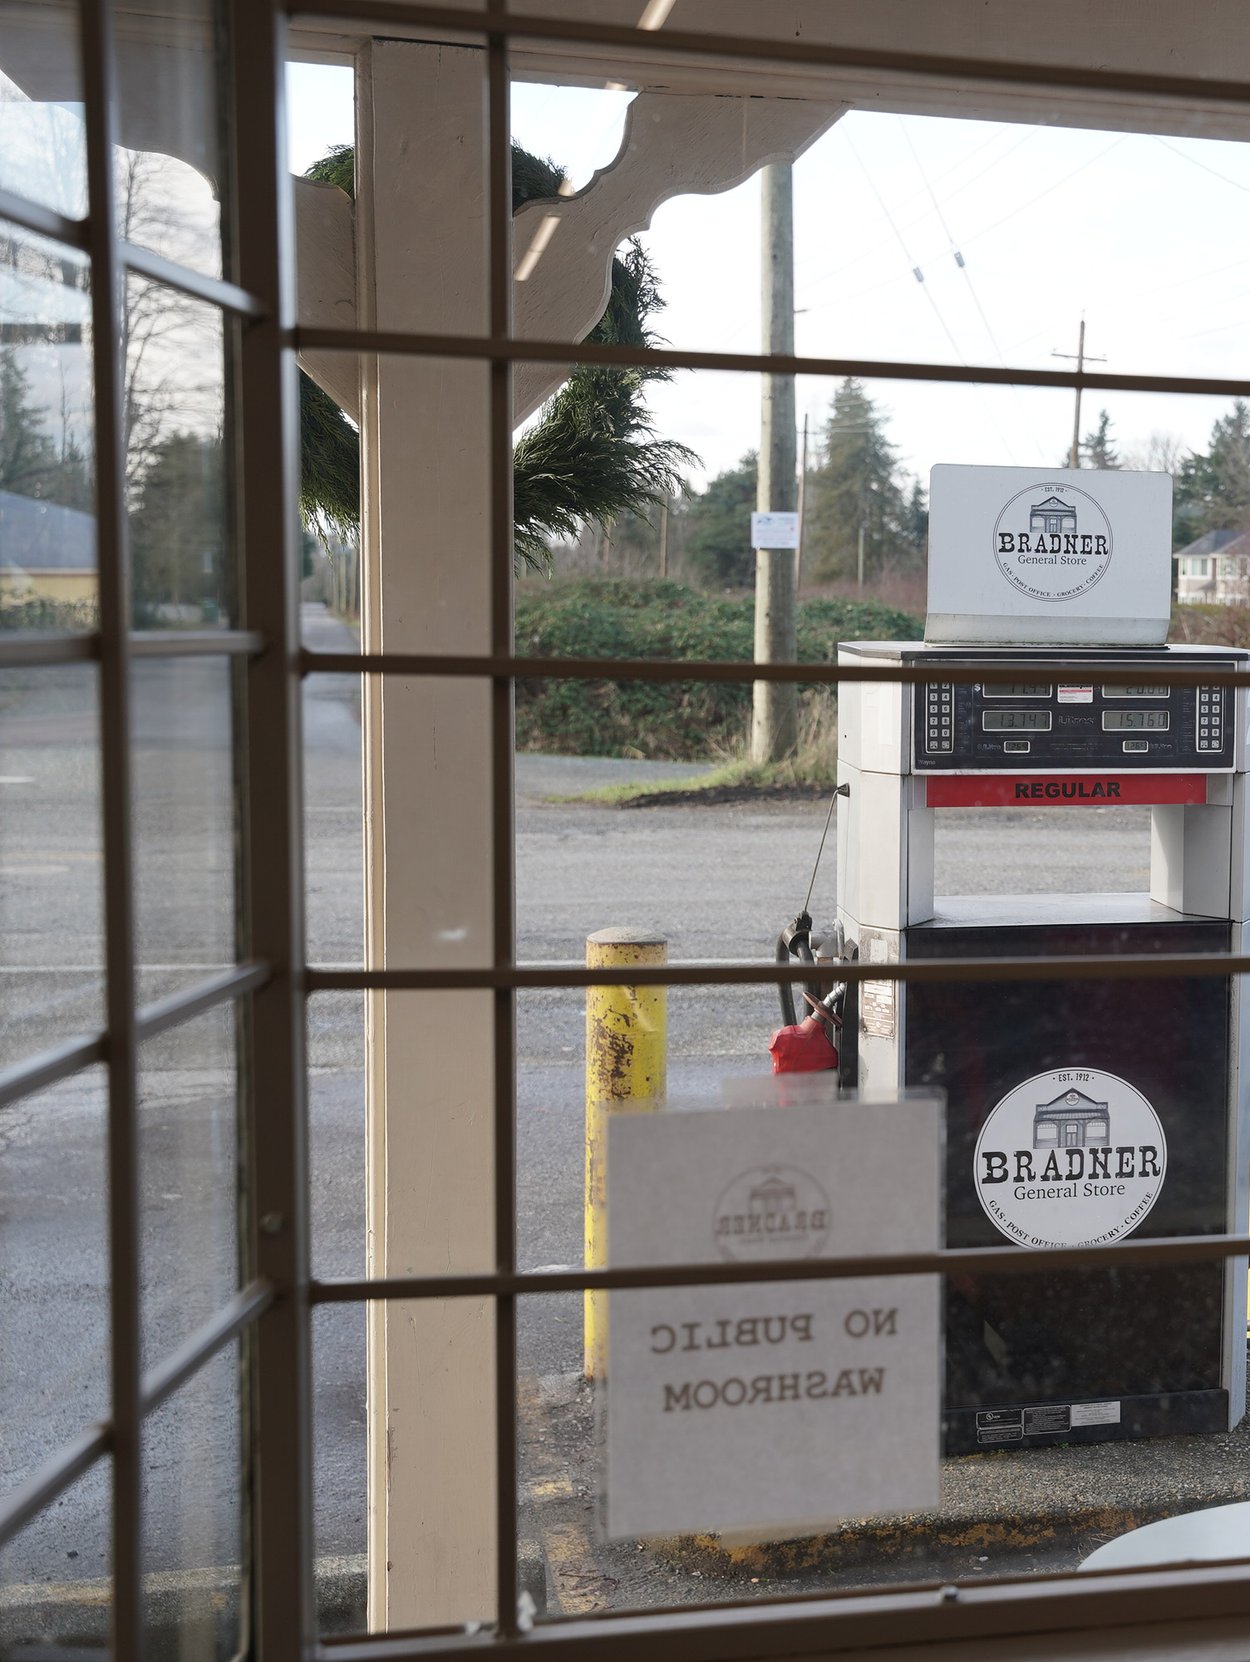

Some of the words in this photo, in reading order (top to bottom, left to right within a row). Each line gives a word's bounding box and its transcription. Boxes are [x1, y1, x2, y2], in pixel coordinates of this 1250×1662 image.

[998, 532, 1109, 555] BRADNER
[1018, 554, 1057, 565] General
[1060, 556, 1087, 566] Store
[1001, 713, 1048, 728] 13.747
[1120, 713, 1166, 727] 15.760
[1015, 782, 1121, 799] REGULAR
[1058, 1073, 1073, 1082] EST.
[1075, 1073, 1090, 1082] 1912
[981, 1145, 1161, 1185] BRADNER
[1013, 1184, 1077, 1200] General
[1083, 1182, 1126, 1197] Store
[989, 1199, 1005, 1222] GAS
[1006, 1221, 1030, 1240] POST
[1077, 1226, 1120, 1248] GROCERY
[1124, 1191, 1154, 1225] COFFEE
